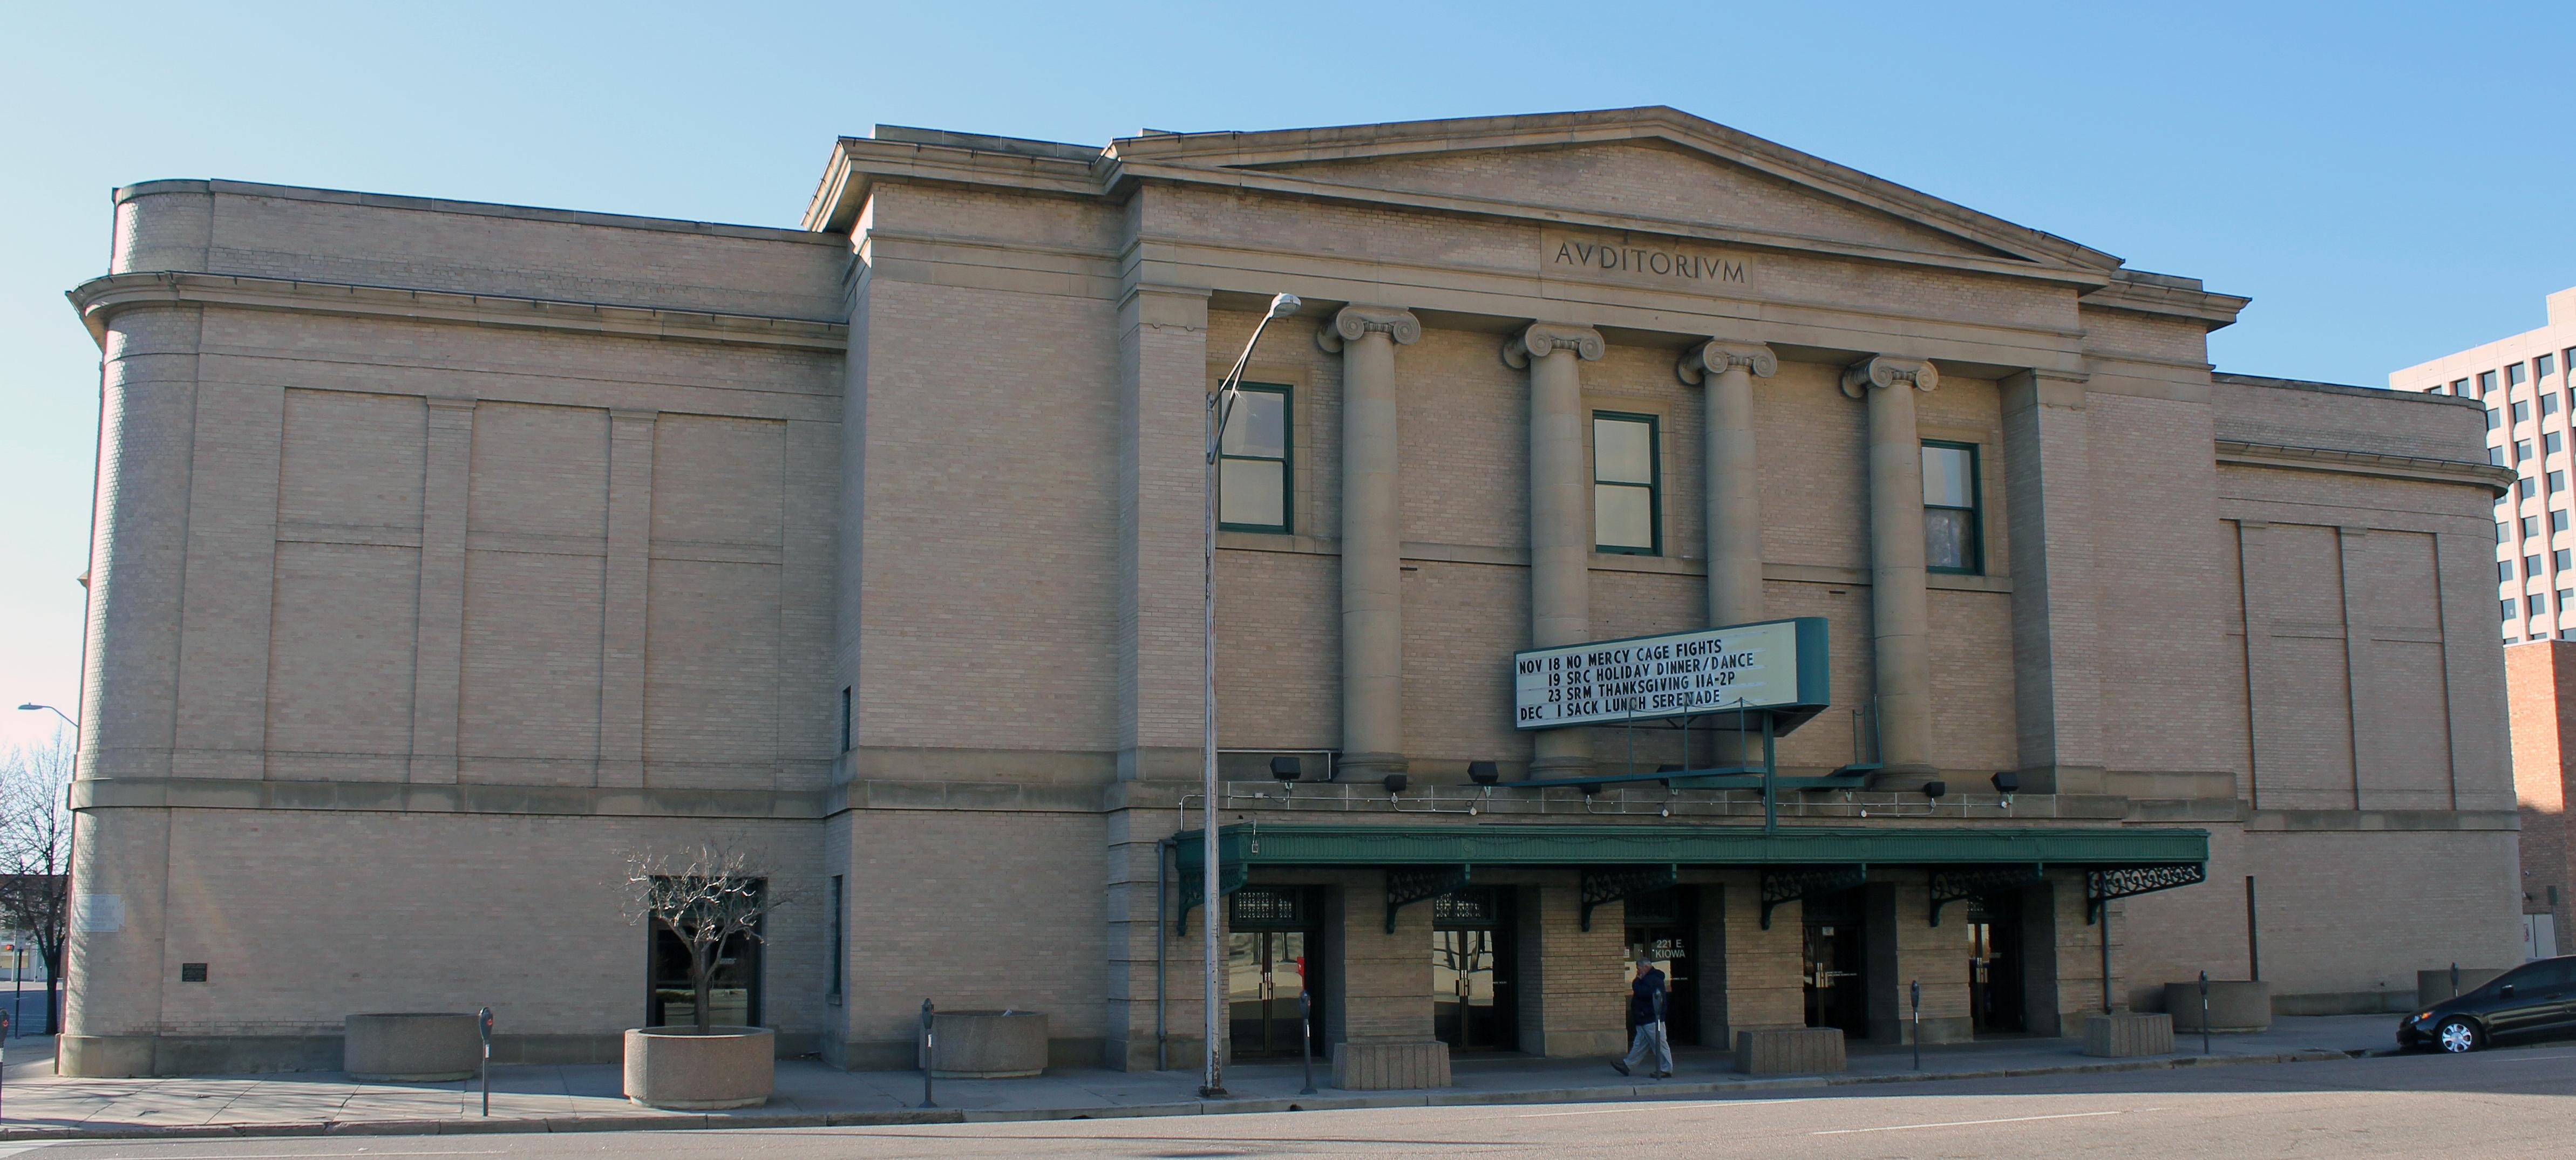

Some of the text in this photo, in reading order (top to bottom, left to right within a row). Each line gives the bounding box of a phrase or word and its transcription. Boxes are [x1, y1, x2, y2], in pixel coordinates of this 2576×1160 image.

[1555, 242, 1745, 283] AVDITORIVM
[1519, 639, 1722, 674] NOV 18 NO MERCY CAGE FIGHTS
[1548, 653, 1753, 687] 19 SRC HOLIDAY DINNER/DANCE
[1548, 672, 1735, 702] 23 SRM THANKSGIVING 11A-2P
[1521, 690, 1720, 721] DEC 1 SACK LUNCH SERENADE
[1655, 950, 1685, 958] KIOWA
[1657, 939, 1671, 948] 221
